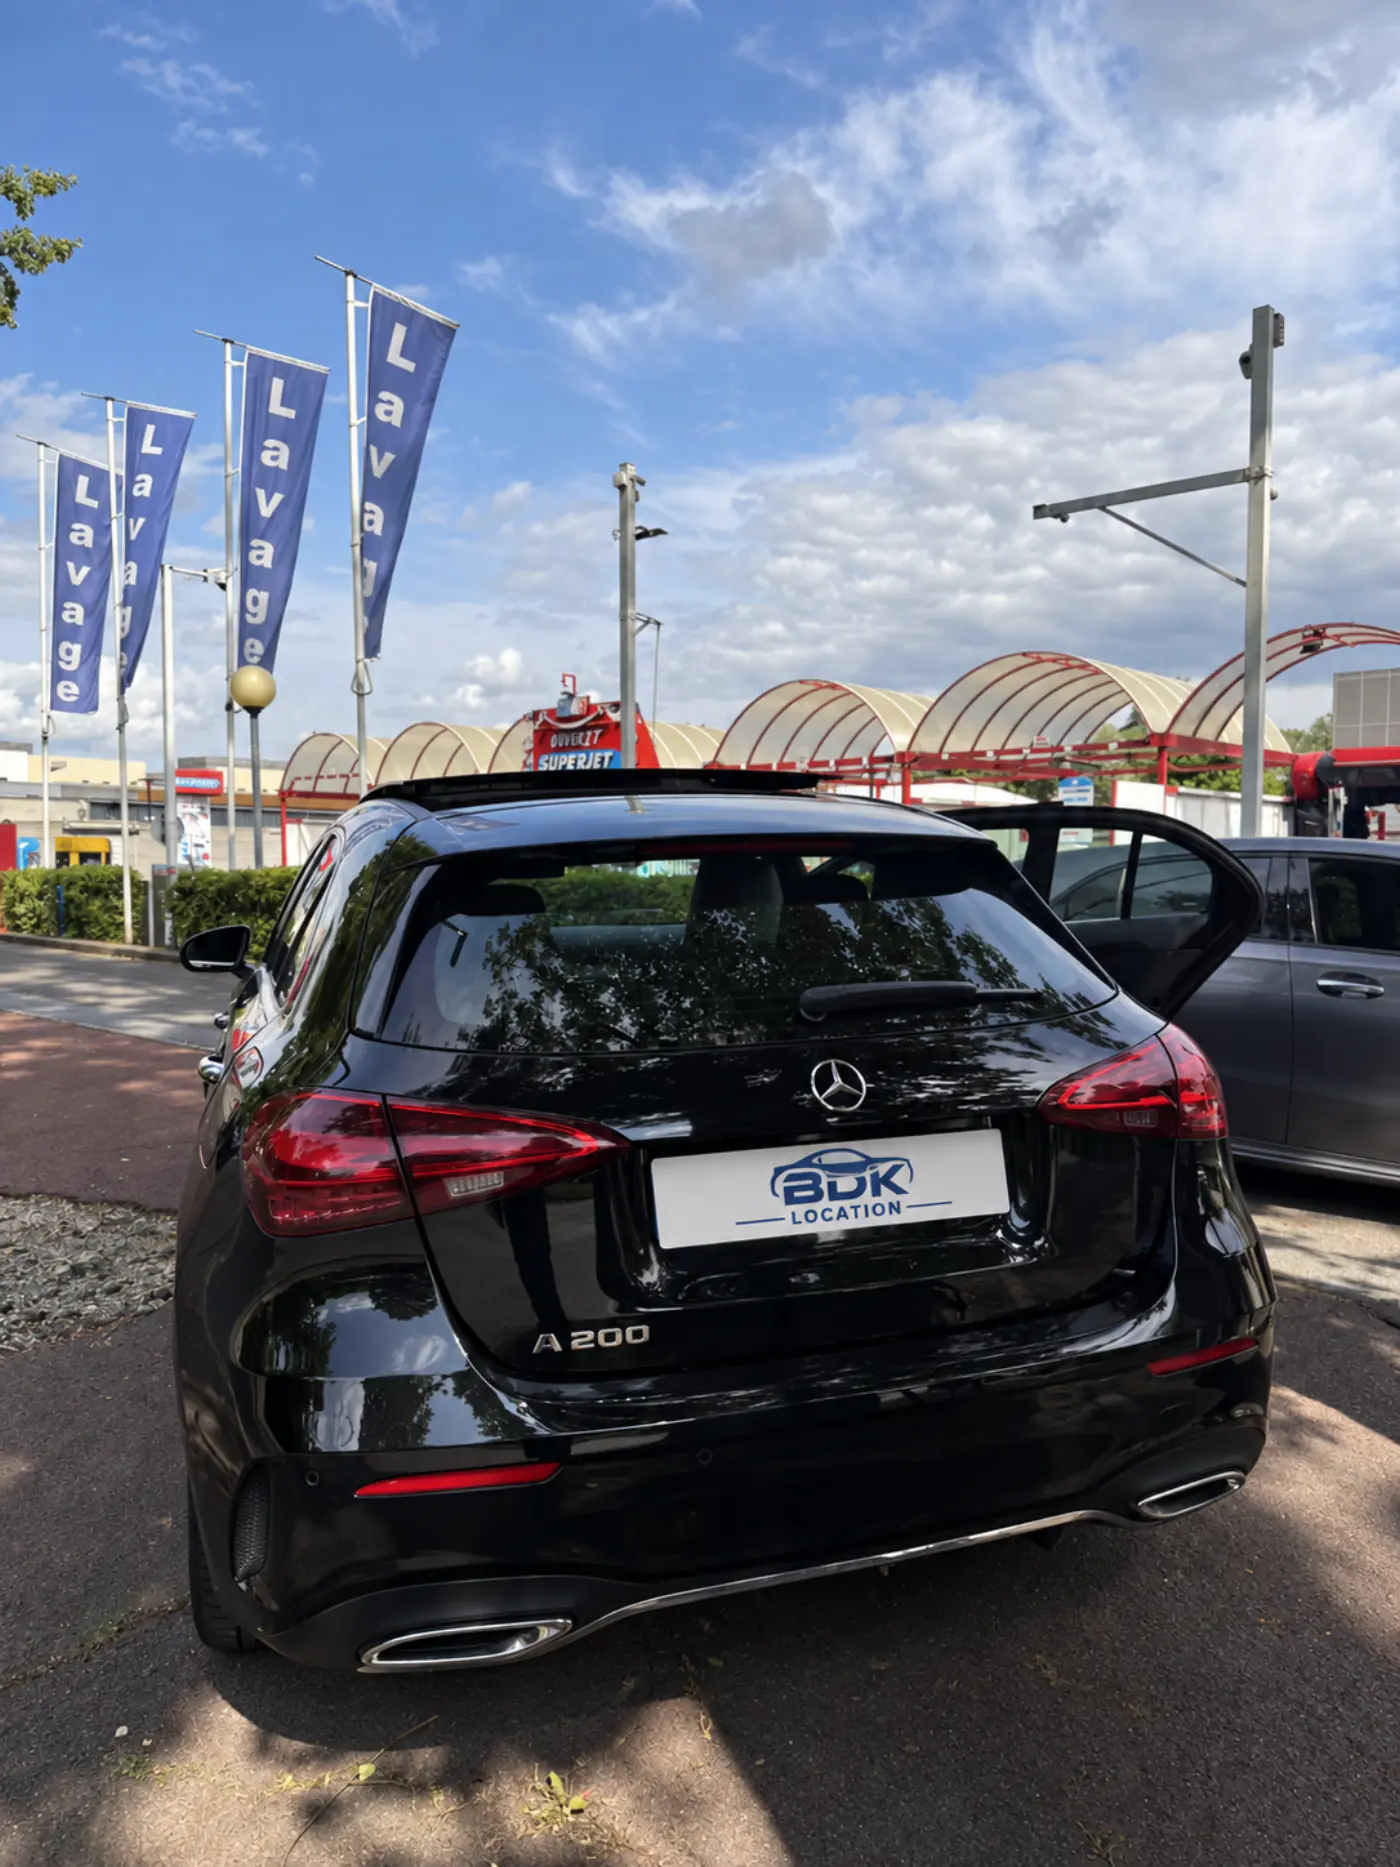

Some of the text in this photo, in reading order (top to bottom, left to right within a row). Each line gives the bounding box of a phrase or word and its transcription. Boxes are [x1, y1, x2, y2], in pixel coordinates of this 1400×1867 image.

[362, 321, 418, 634] Lavag
[243, 376, 297, 665] Lavage
[56, 474, 99, 702] Lavage
[538, 751, 614, 771] SUPERJET
[782, 1161, 911, 1207] BDK
[790, 1200, 903, 1226] LOCATION
[532, 1324, 651, 1355] A 200
